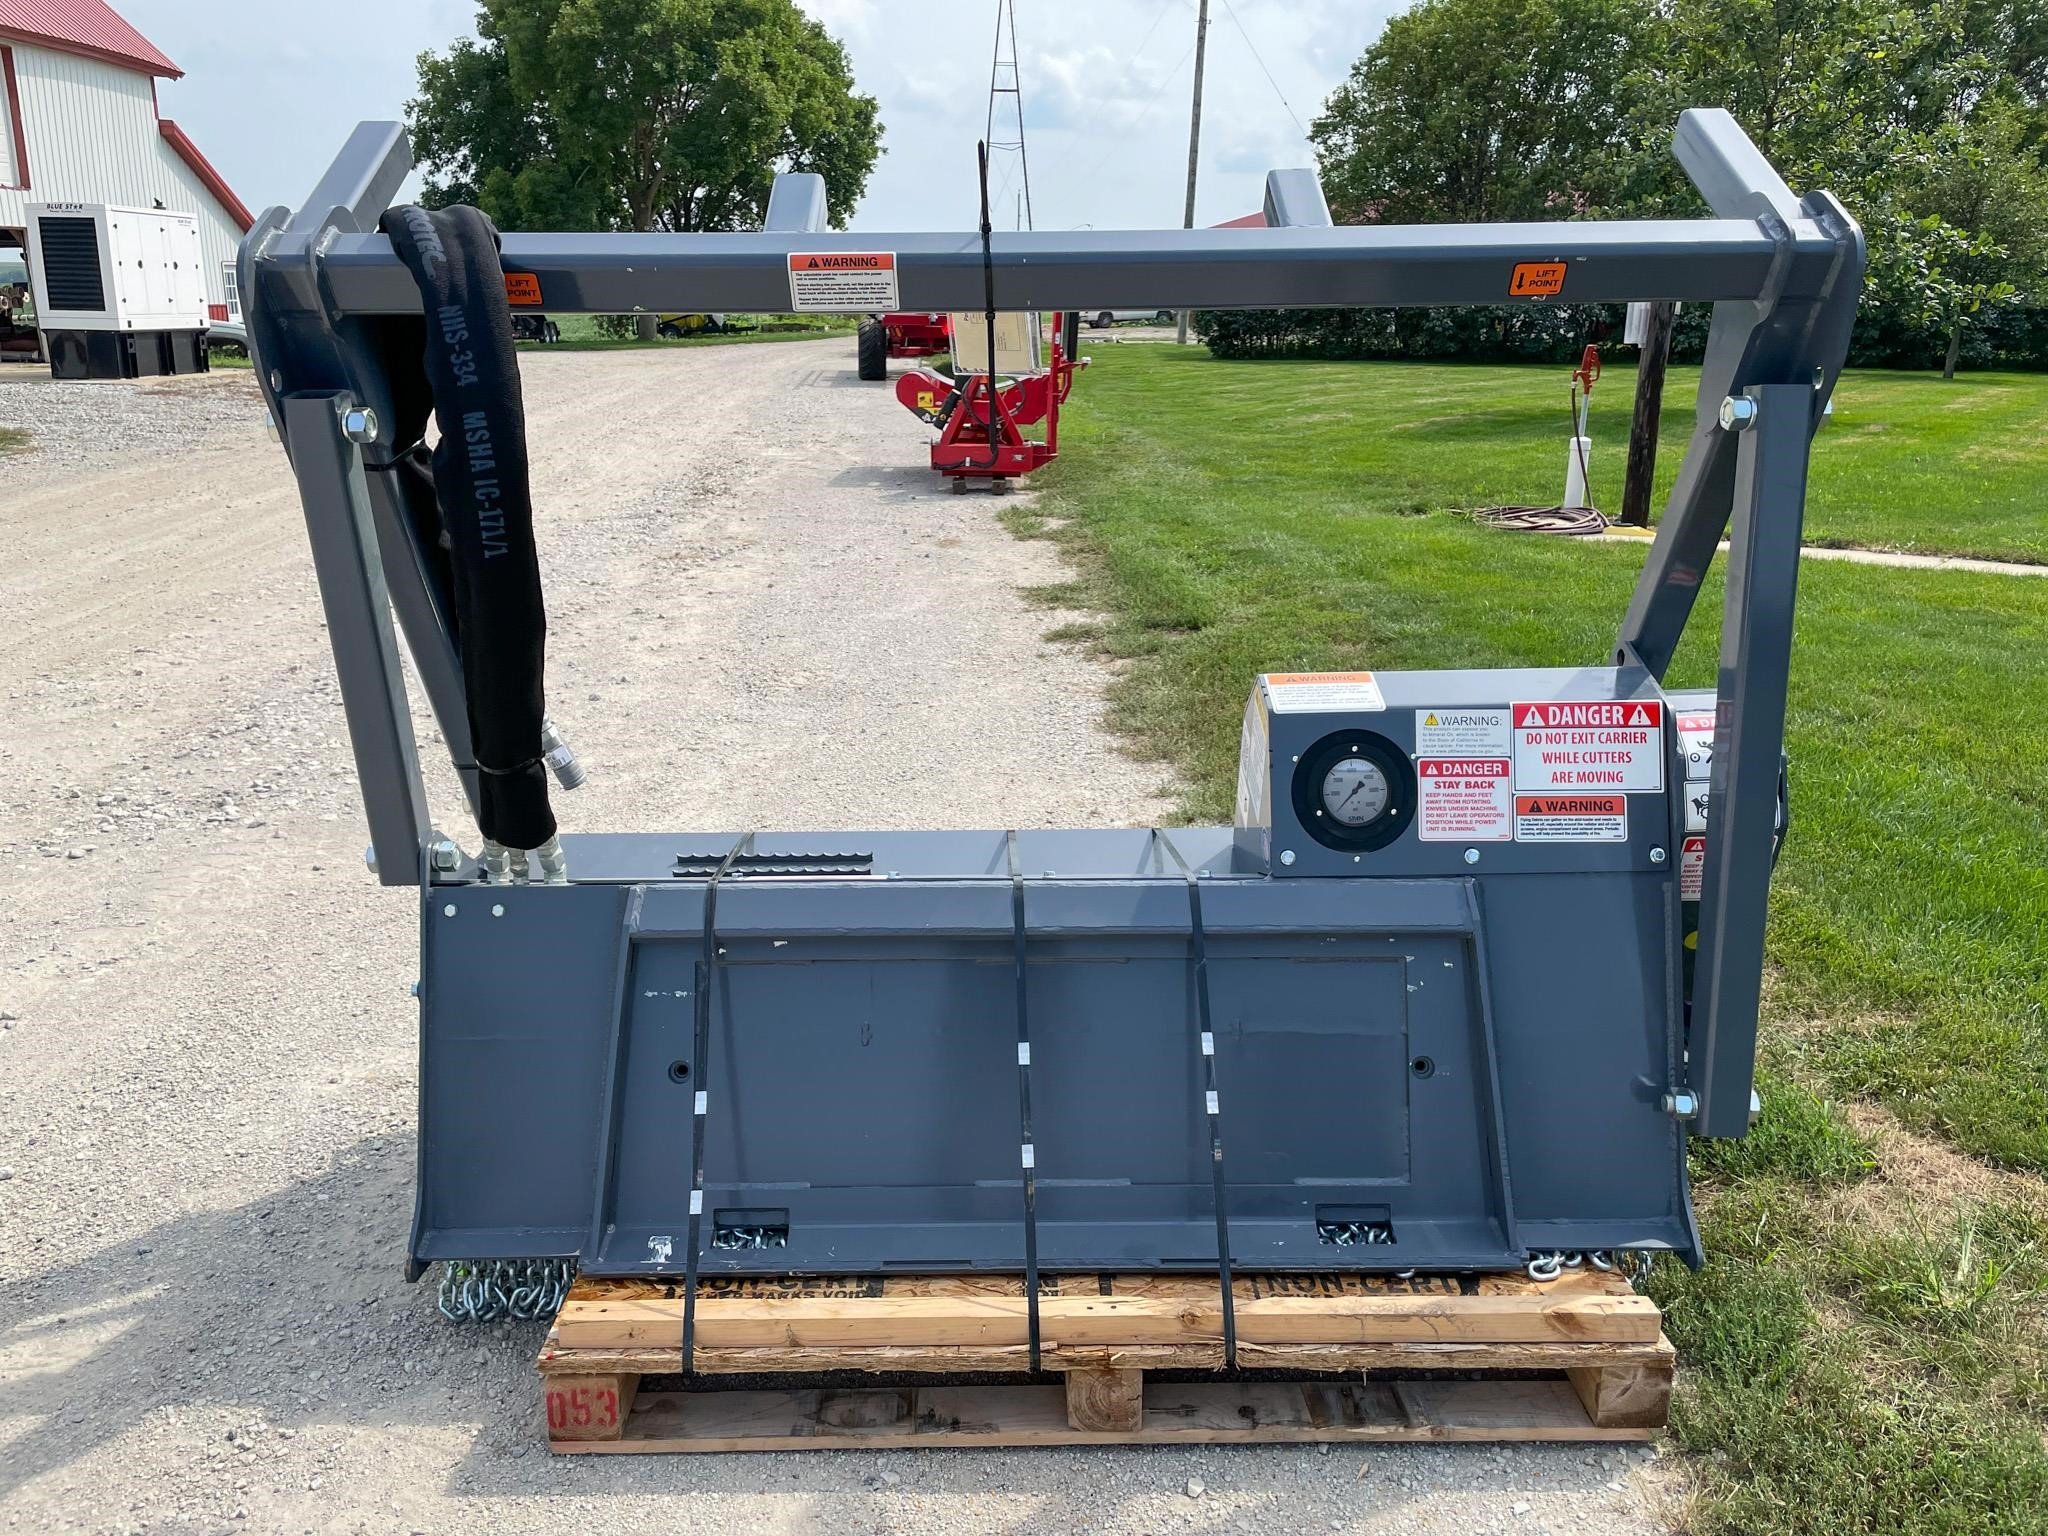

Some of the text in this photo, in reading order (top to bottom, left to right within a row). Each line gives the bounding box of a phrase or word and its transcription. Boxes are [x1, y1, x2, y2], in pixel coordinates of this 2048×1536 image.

[822, 257, 878, 267] WARNING
[438, 304, 478, 386] NHS-334
[462, 411, 508, 558] MSHA IC-171/1
[1440, 716, 1502, 726] WARNING:
[1548, 705, 1624, 725] DANGER
[1526, 732, 1647, 744] DO NOT EXIT CARRIER
[1542, 752, 1632, 764] WHILE CUTTERS
[1442, 764, 1502, 774] DANGER
[1552, 771, 1623, 783] ARE MOVING
[1434, 781, 1495, 789] STAY BACK
[1546, 800, 1614, 811] WARNING
[752, 1291, 816, 1299] MARKS
[547, 1389, 617, 1428] 053
